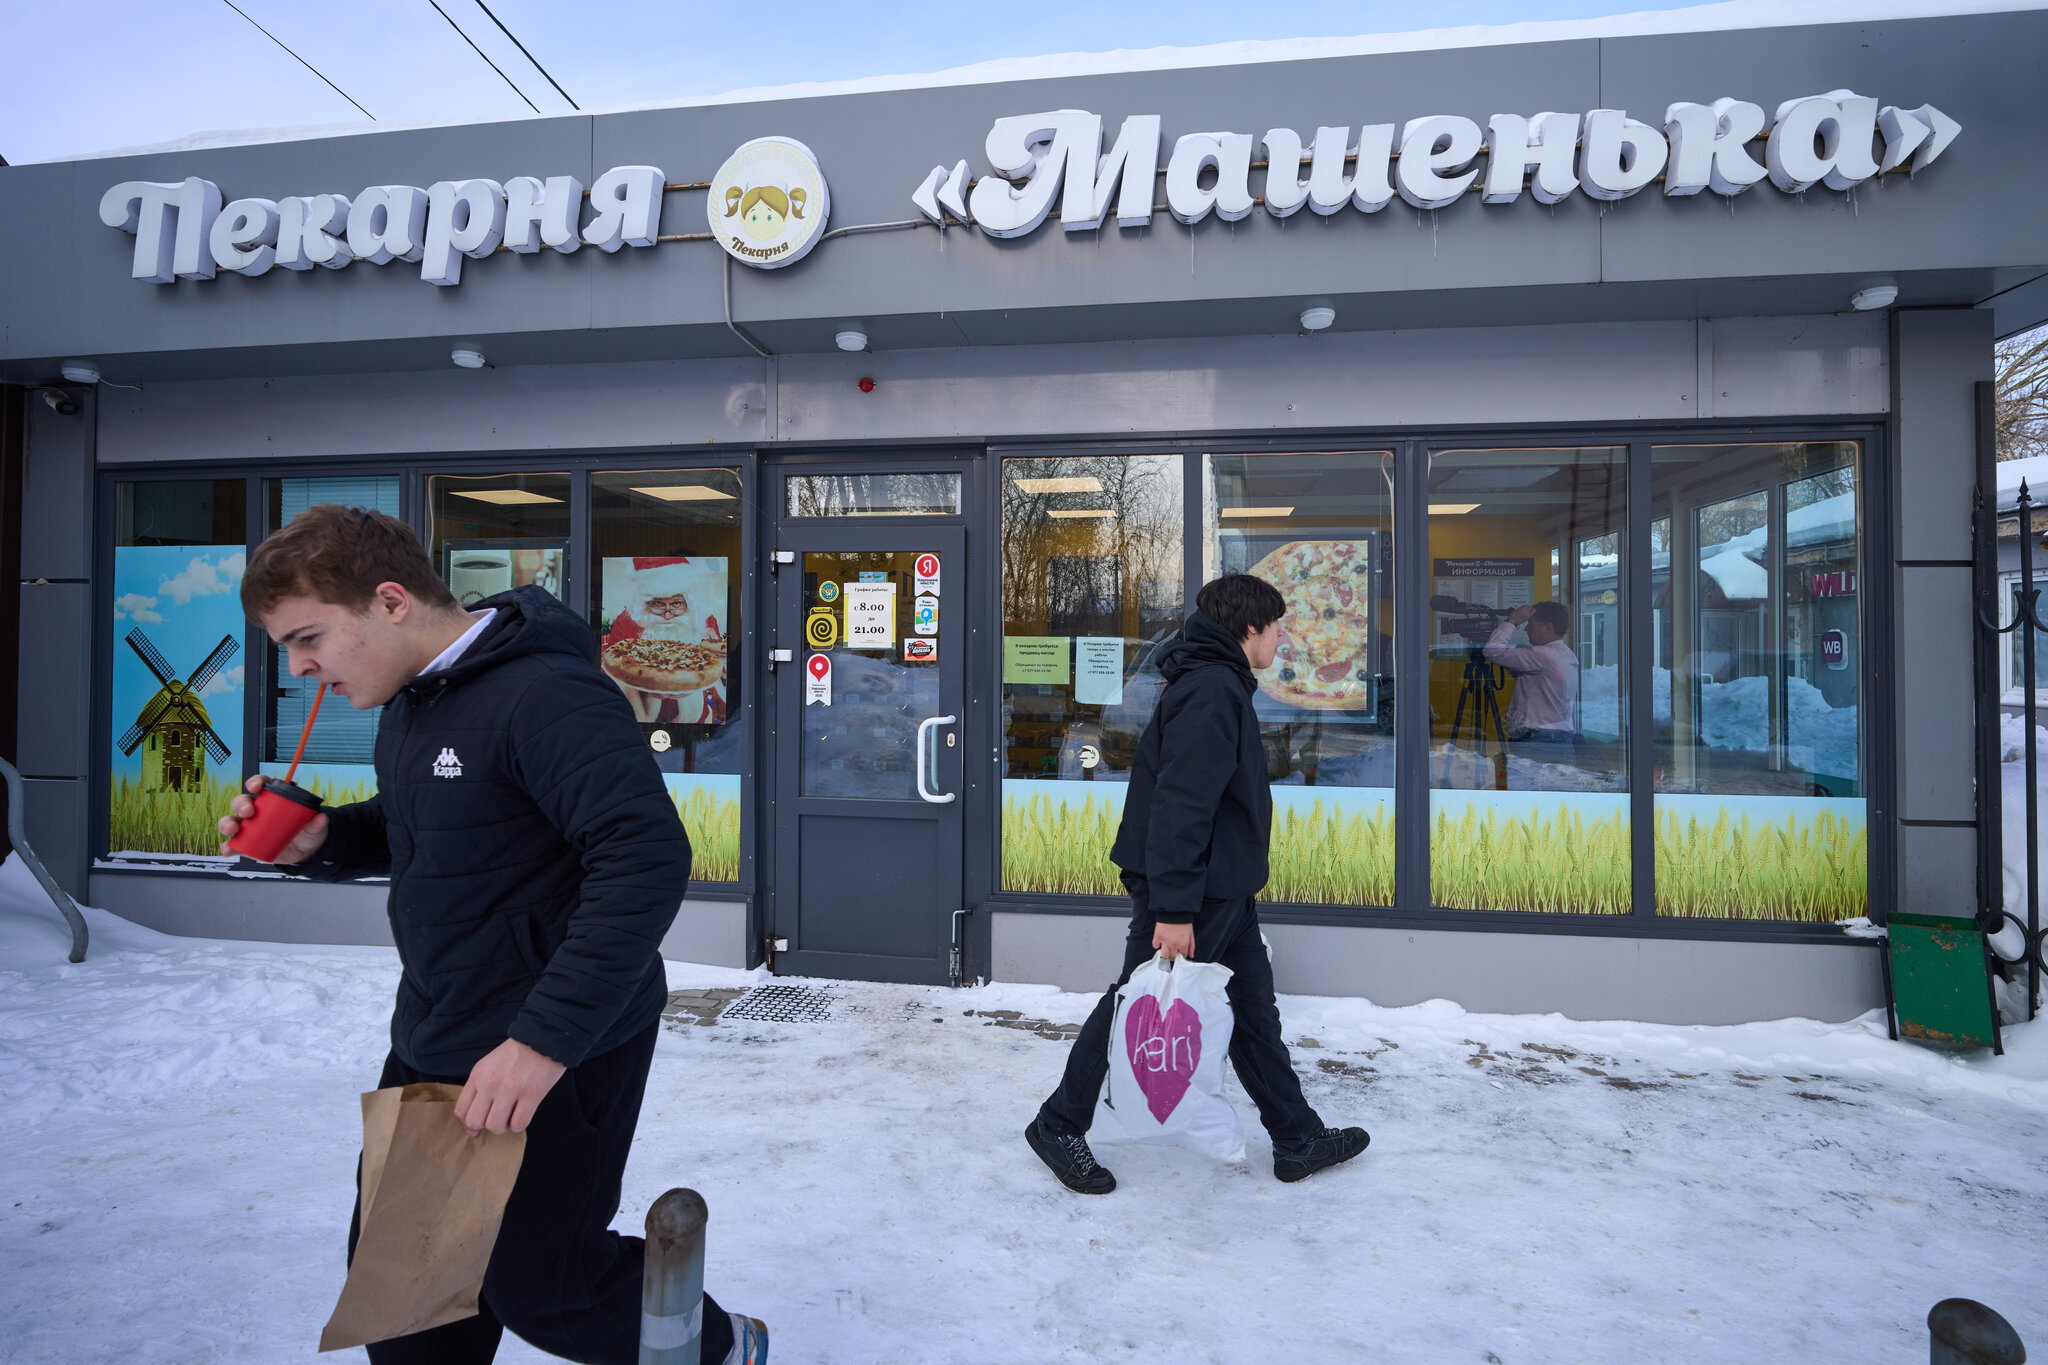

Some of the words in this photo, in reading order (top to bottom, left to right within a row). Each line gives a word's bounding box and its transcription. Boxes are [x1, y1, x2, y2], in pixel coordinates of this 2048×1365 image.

[99, 166, 665, 285] Пекарня
[912, 93, 1962, 237] «Машенька»
[732, 236, 789, 260] Пекарня
[923, 559, 932, 573] Я
[1451, 567, 1516, 576] ИНФОРМАЦИЯ
[860, 601, 885, 612] 8.00
[854, 626, 885, 634] 21.00
[1823, 640, 1841, 655] WB
[433, 765, 463, 779] Kappa
[1133, 1015, 1194, 1073] kari
